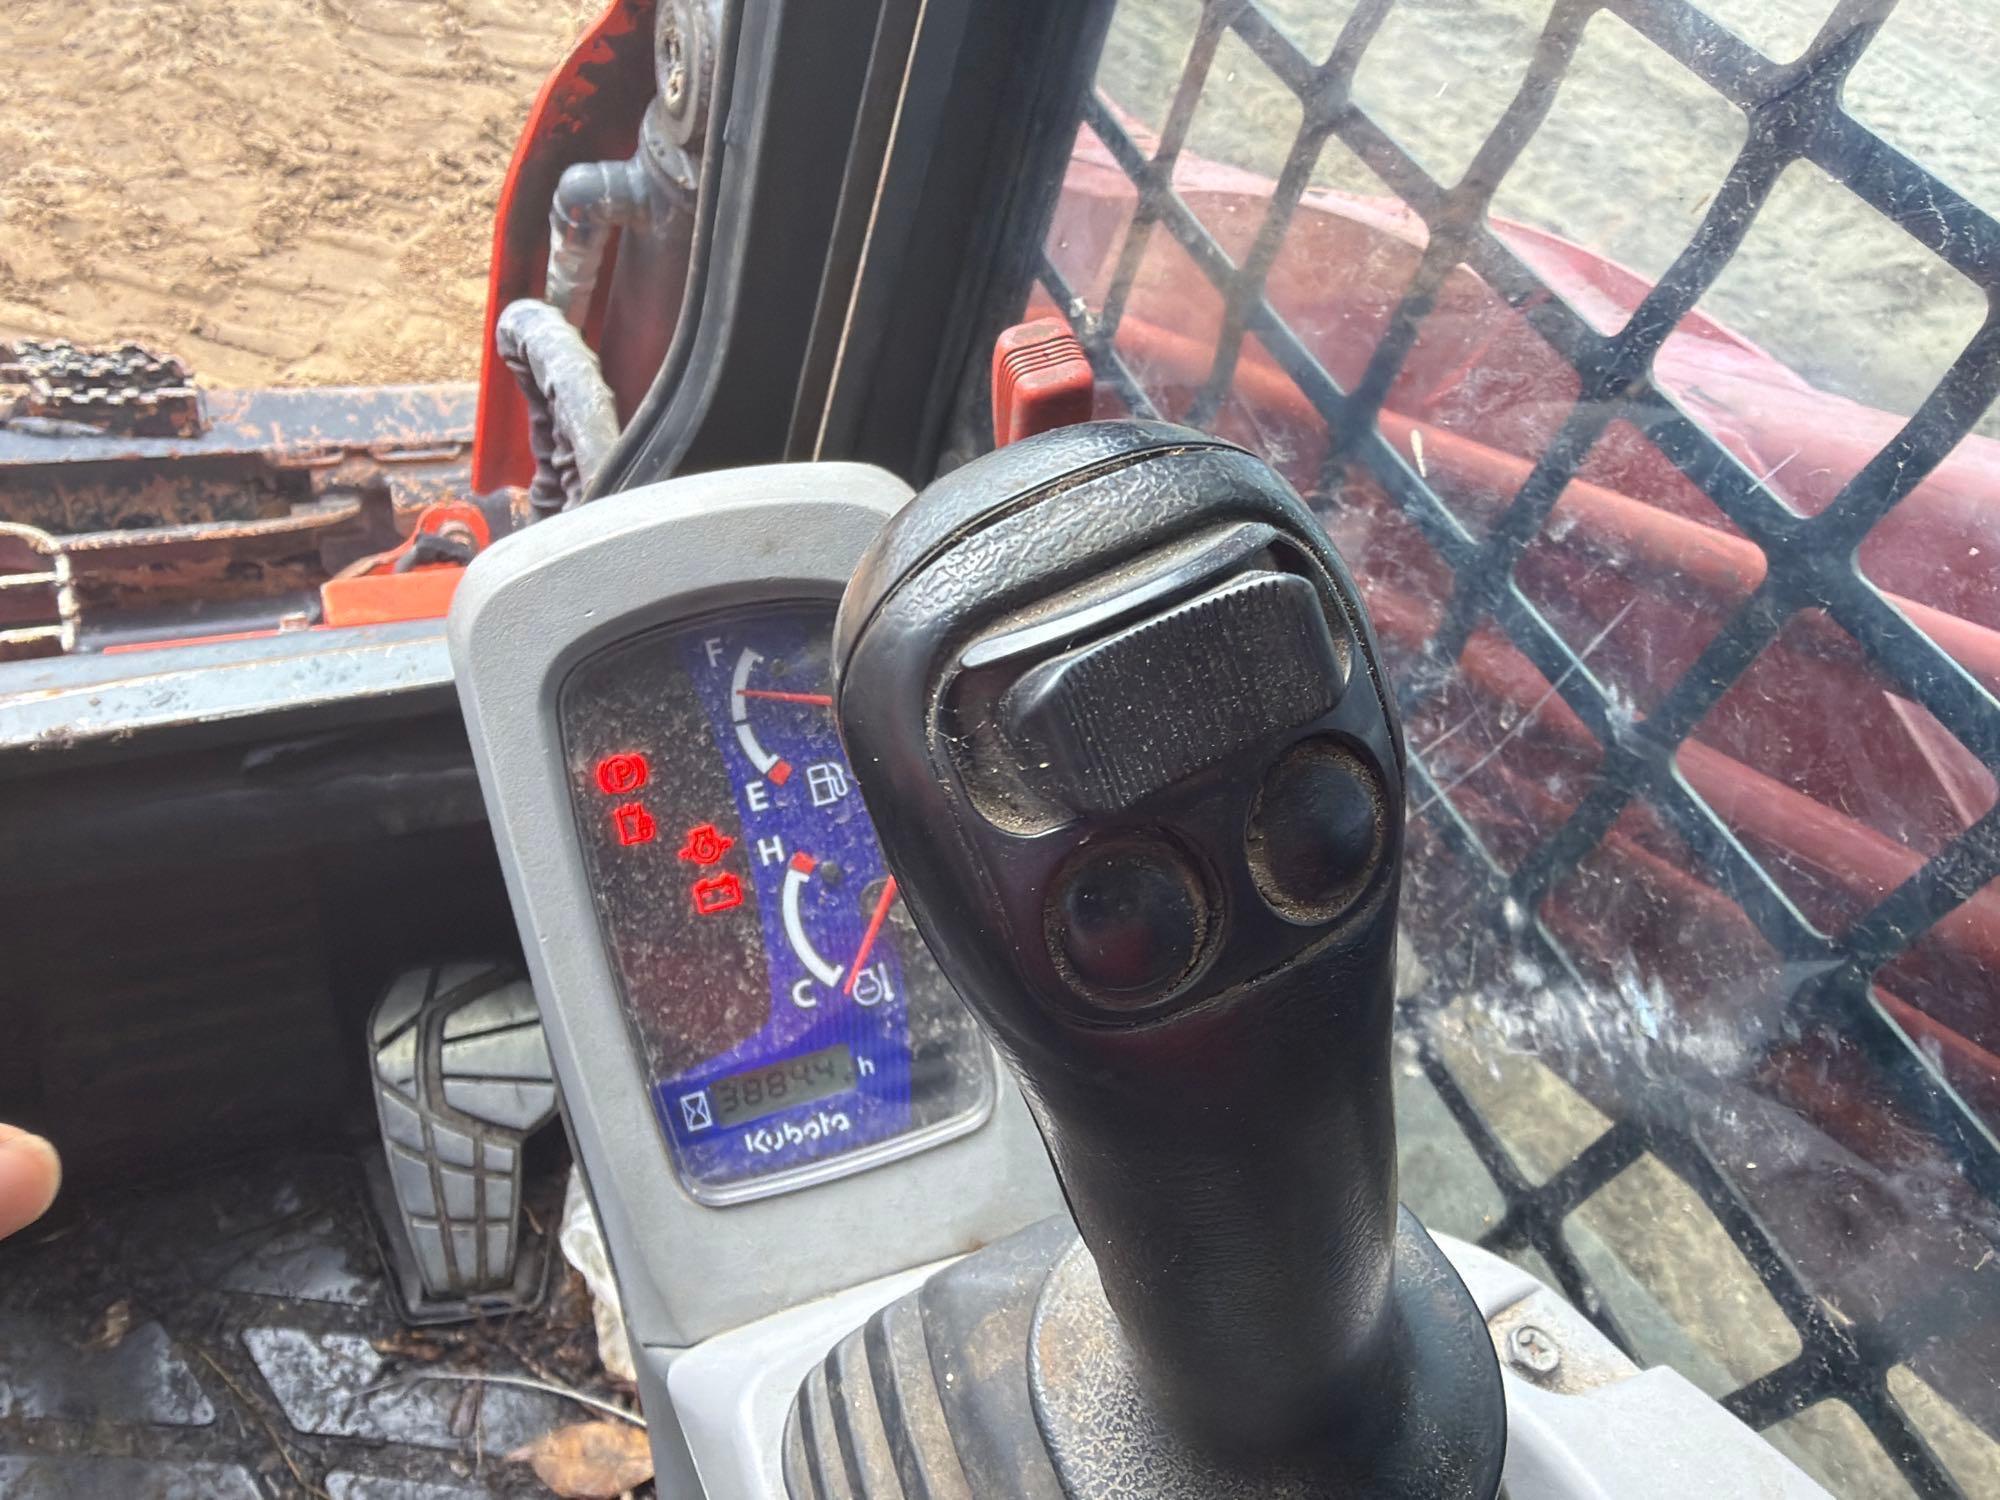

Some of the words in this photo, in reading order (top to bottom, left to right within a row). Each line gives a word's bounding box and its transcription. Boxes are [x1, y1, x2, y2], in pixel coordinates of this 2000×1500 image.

[705, 637, 723, 668] F
[745, 780, 769, 812] E
[757, 834, 785, 867] H
[792, 978, 817, 1008] C
[857, 1056, 876, 1077] h
[744, 1111, 850, 1154] Kubota
